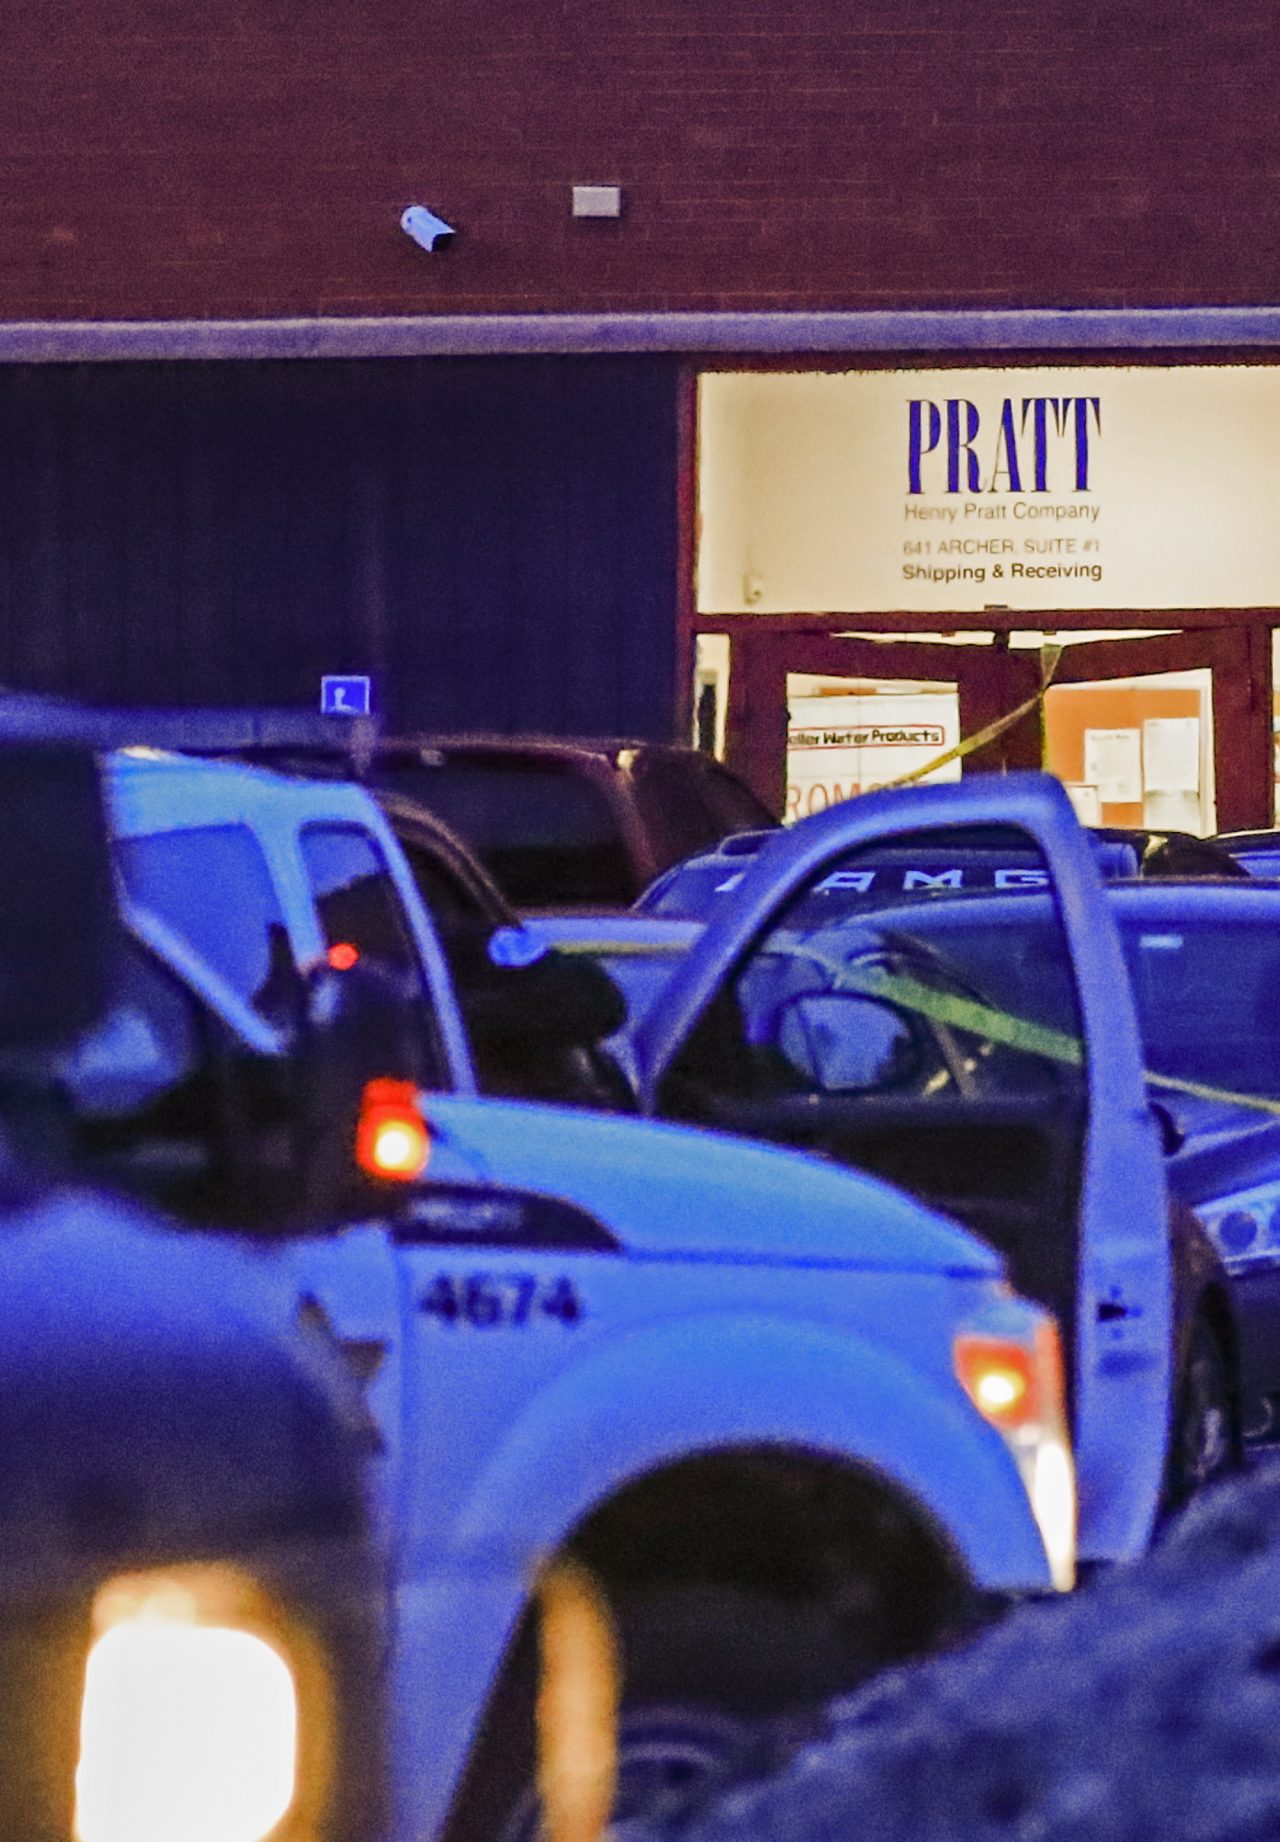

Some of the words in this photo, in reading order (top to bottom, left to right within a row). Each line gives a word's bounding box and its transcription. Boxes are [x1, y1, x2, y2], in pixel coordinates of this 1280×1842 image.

[906, 396, 1101, 494] PRATT
[904, 504, 957, 523] Henry
[964, 503, 1006, 519] Pratt
[1013, 502, 1101, 521] Company
[903, 541, 931, 555] 641
[1024, 538, 1076, 553] SUITE
[902, 565, 986, 583] Shipping
[992, 564, 1003, 578] &
[1011, 562, 1102, 581] Receiving
[872, 729, 939, 742] Products
[420, 1271, 580, 1330] 4674
